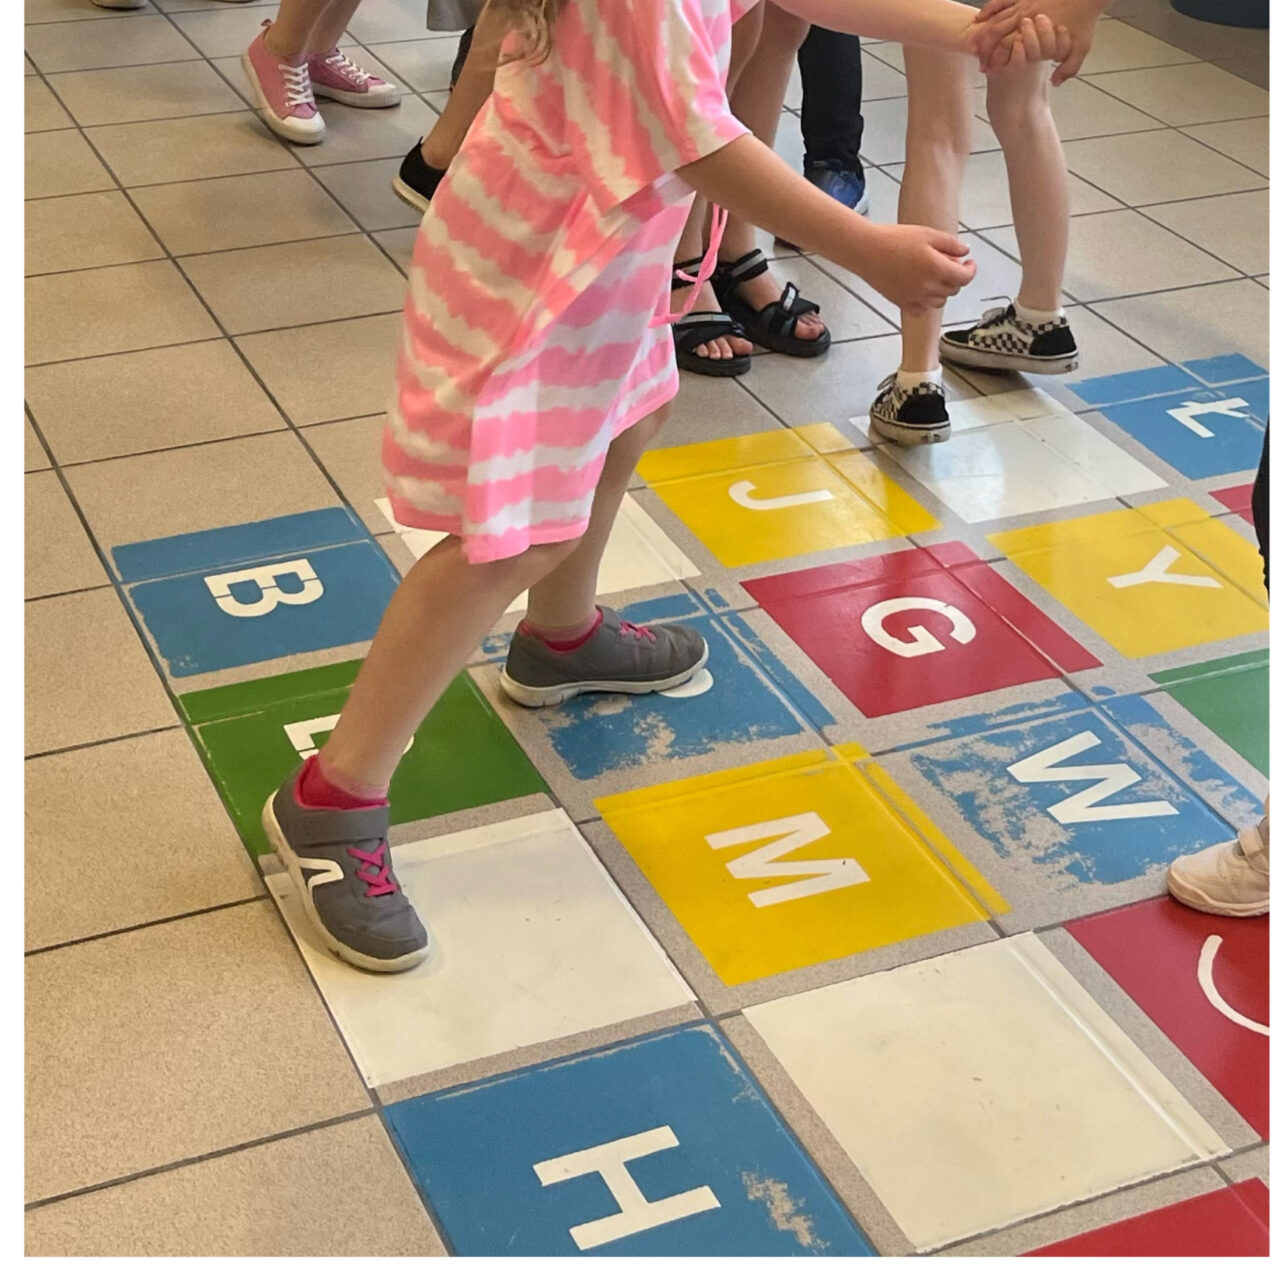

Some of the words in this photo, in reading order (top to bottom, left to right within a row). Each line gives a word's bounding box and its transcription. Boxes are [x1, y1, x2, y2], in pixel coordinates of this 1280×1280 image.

[728, 480, 834, 511] J
[204, 558, 325, 617] B
[1107, 545, 1225, 589] Y
[861, 596, 977, 658] G
[1006, 730, 1181, 826] W
[704, 811, 872, 909] M
[532, 1125, 722, 1252] H
